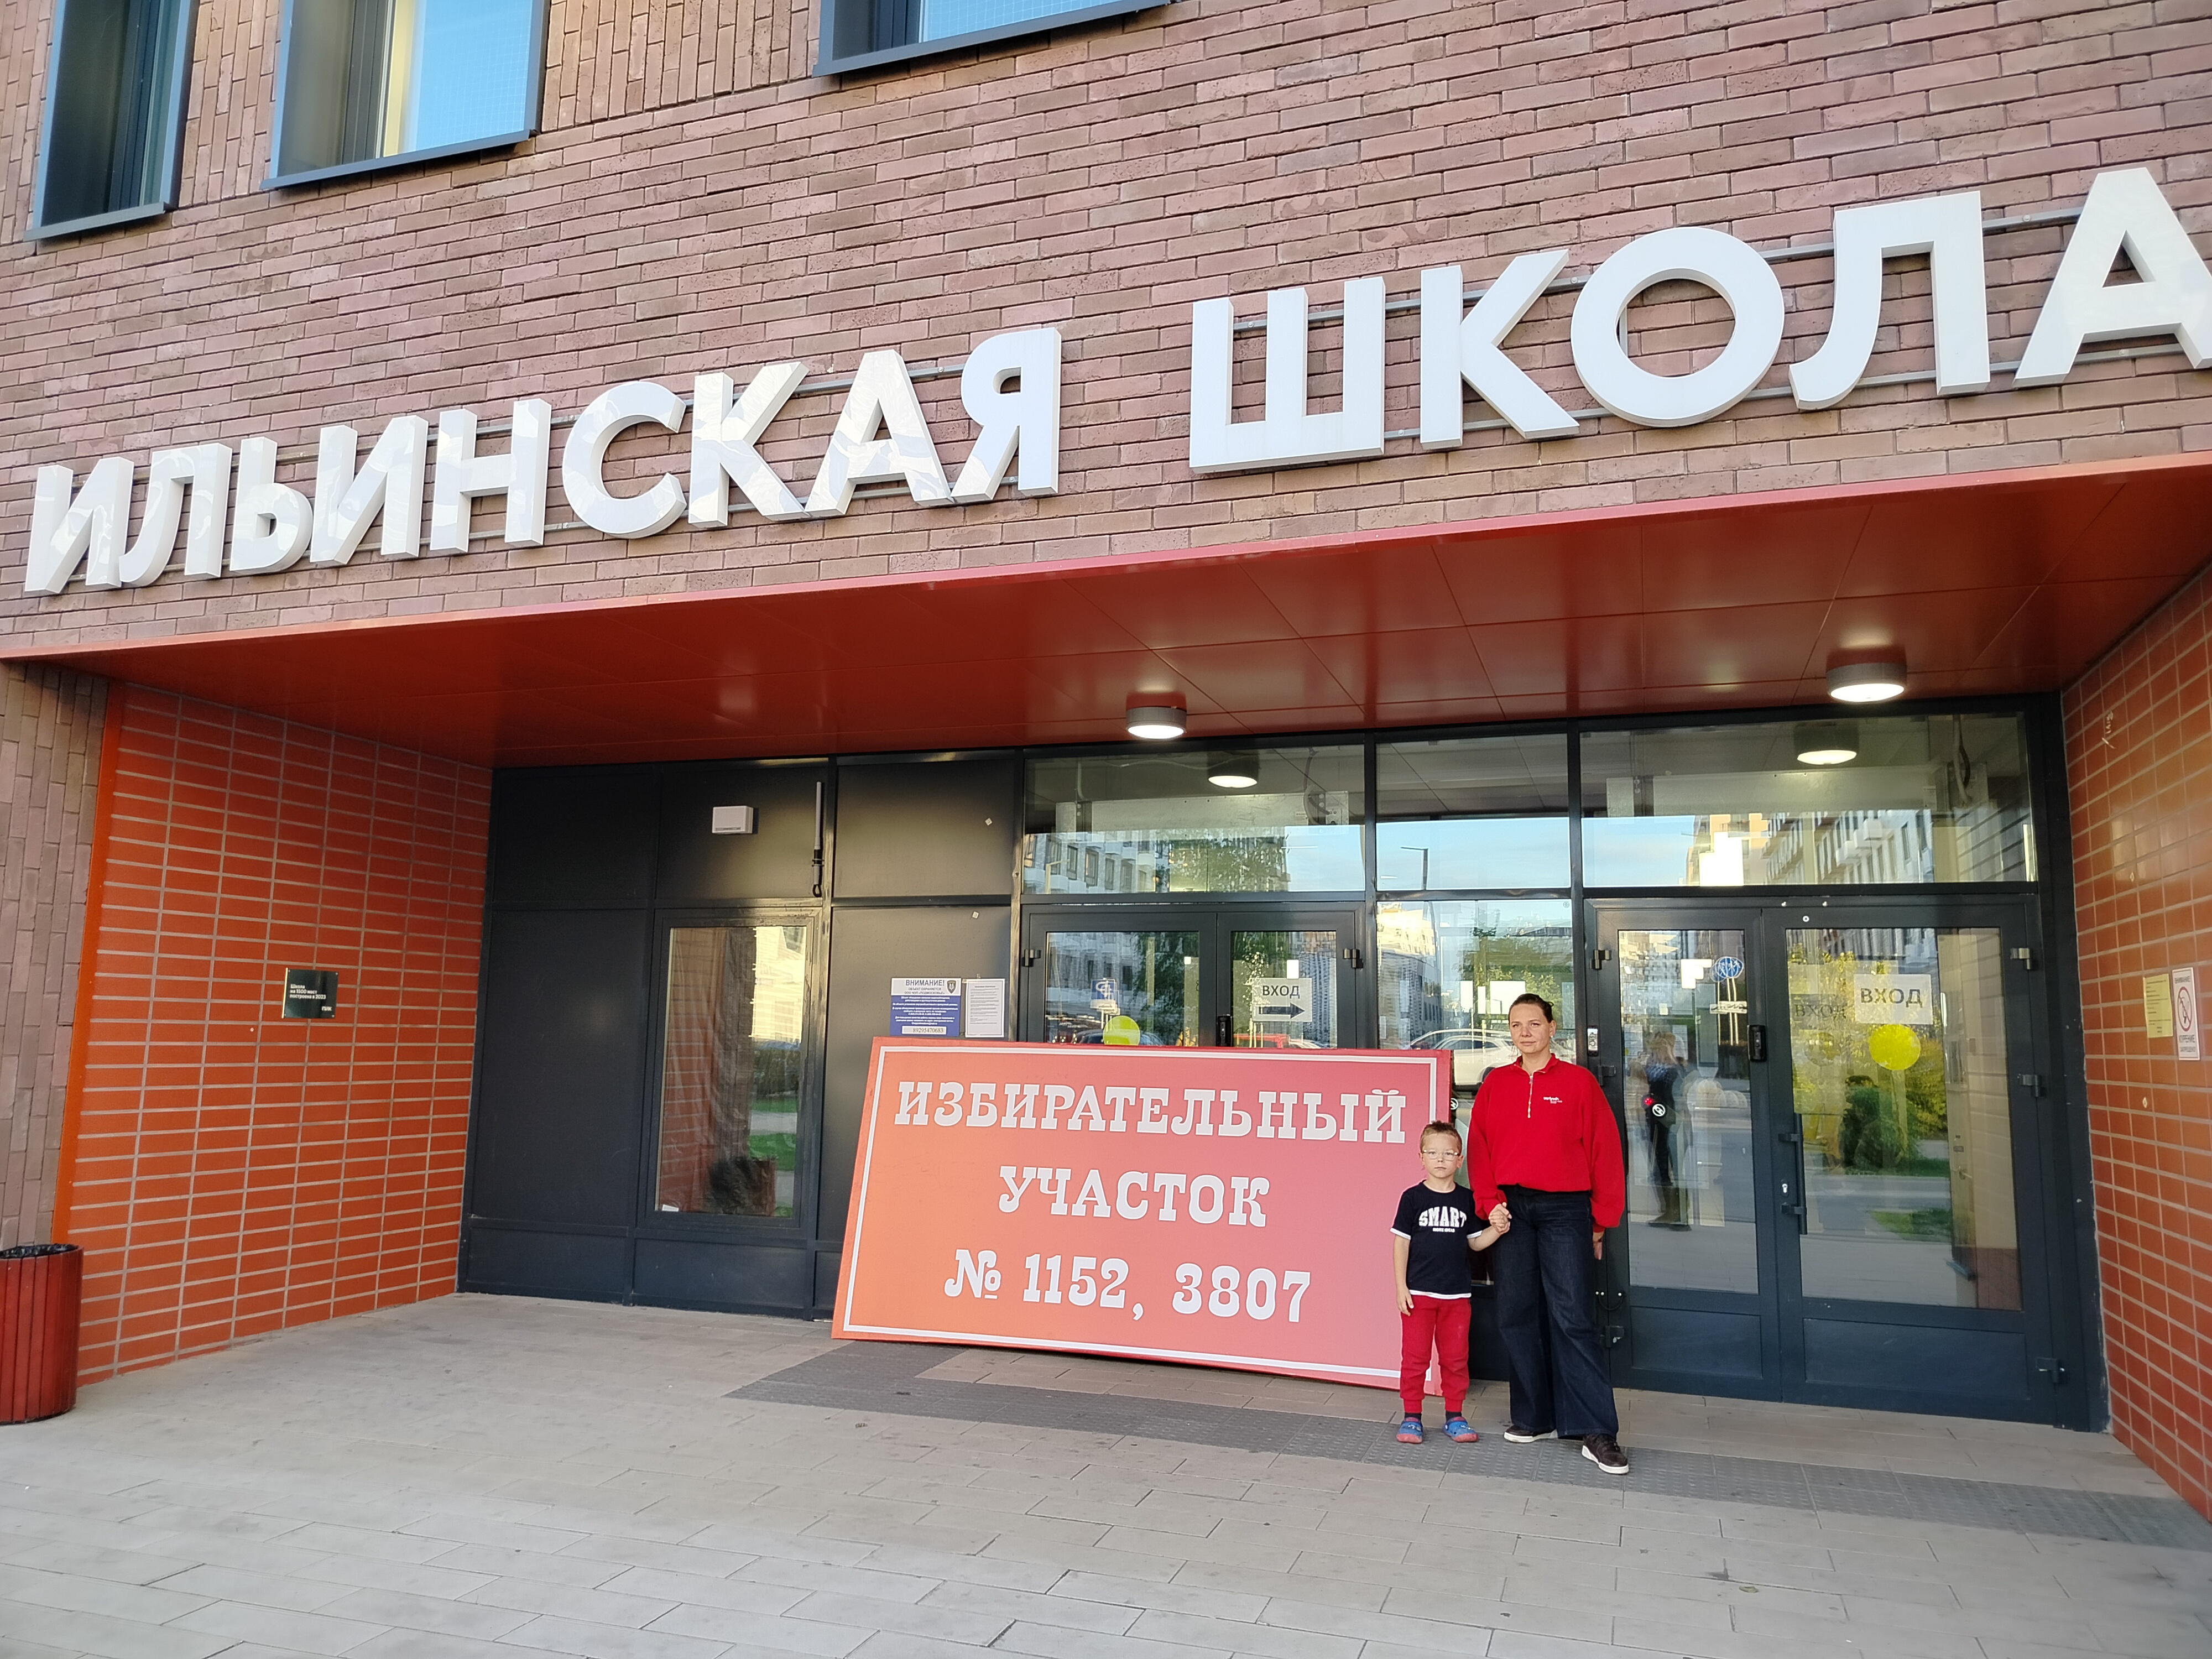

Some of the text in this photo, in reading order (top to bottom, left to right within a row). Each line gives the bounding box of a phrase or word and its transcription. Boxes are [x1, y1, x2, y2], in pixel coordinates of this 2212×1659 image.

[24, 168, 2212, 597] ИЛЬИНСКАЯ ШКОЛА
[1262, 985, 1300, 999] ВХОД
[1860, 988, 1923, 1008] ВХОД
[894, 1081, 1406, 1144] ИЗБИРАТЕЛЬНЫЙ
[999, 1166, 1270, 1227] УЧАСТОК
[1418, 1206, 1467, 1228] SMART
[945, 1249, 1312, 1323] № 1152, 3807
